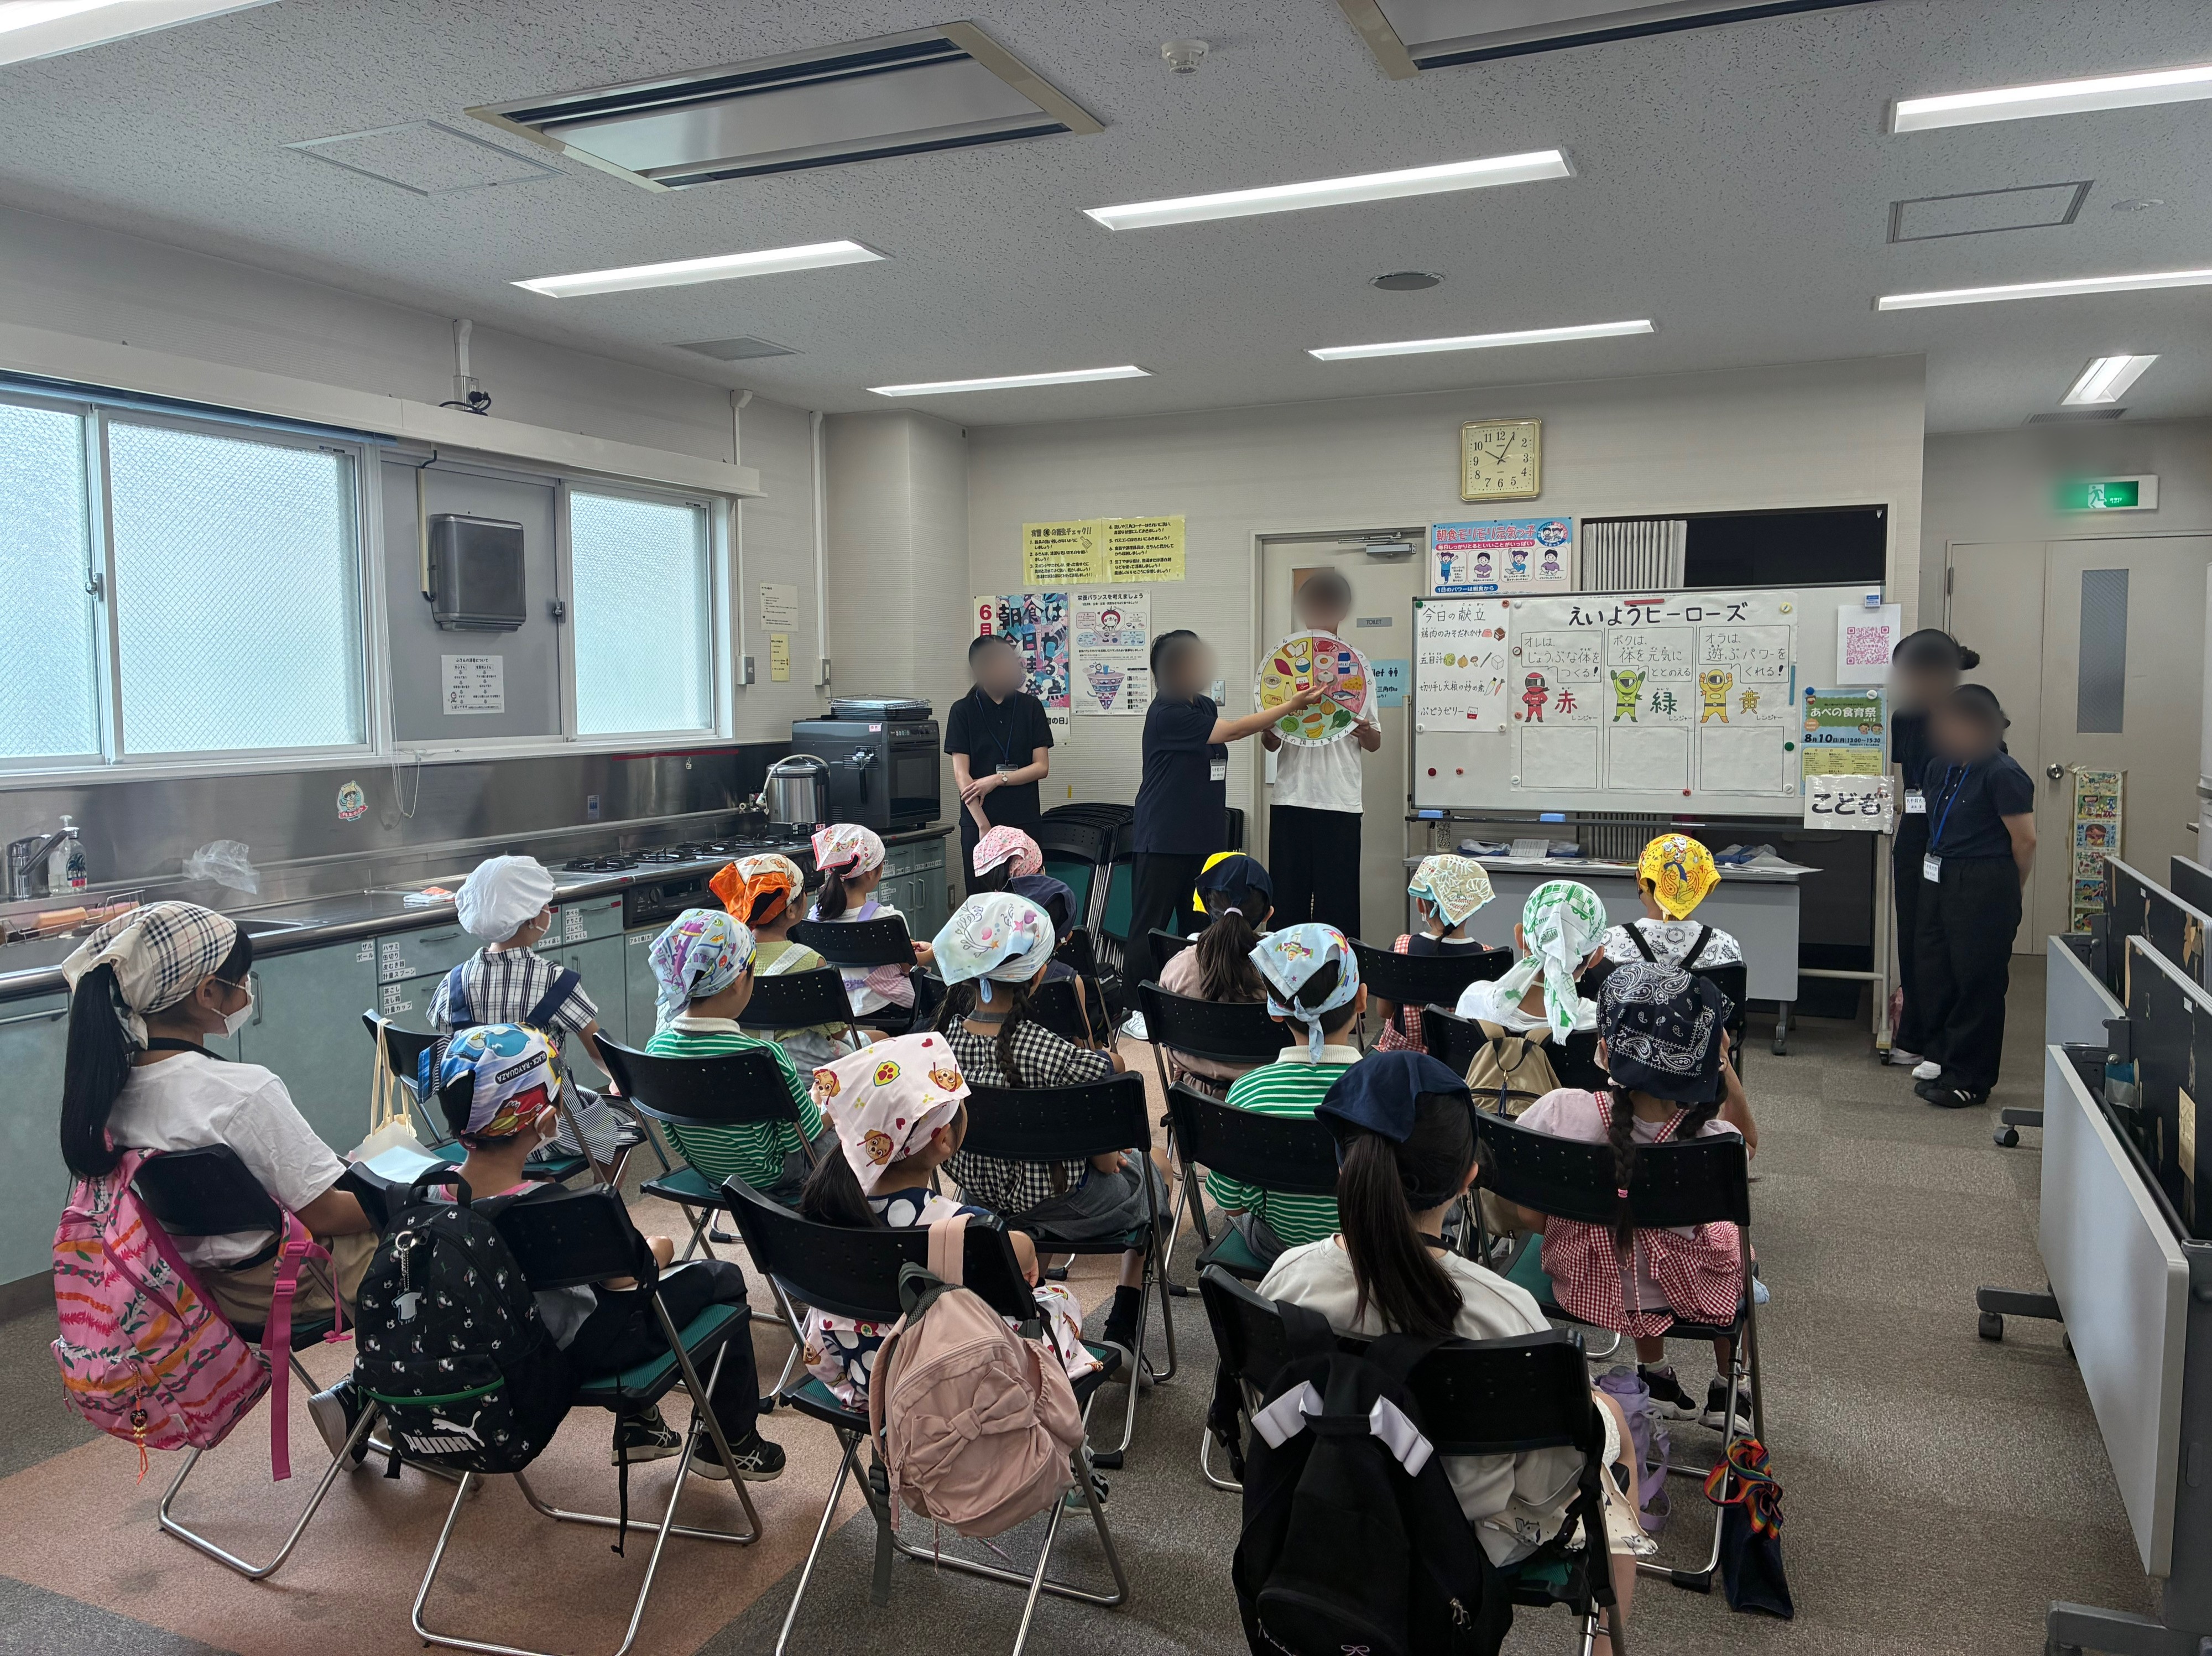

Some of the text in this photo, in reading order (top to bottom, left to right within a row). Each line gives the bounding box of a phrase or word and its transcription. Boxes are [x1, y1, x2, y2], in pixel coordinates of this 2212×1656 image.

[1484, 433, 1492, 442] 11
[1496, 431, 1505, 441] 12
[1474, 441, 1483, 451] 10
[1521, 438, 1527, 447] 2
[1473, 456, 1479, 466] 9
[1523, 453, 1528, 462] 3
[1475, 470, 1480, 480] 8
[1521, 467, 1527, 476] 4
[1485, 478, 1491, 487] 7
[1498, 478, 1503, 487] 6
[1511, 476, 1516, 486] 5
[1436, 524, 1536, 541] 朝食モリモリ元気っ子
[1438, 541, 1532, 550] 毎日しっかりとるといいことがいっぱい
[1077, 593, 1144, 601] 栄養バランスを考えましょう
[1423, 607, 1486, 623] 今日の献立
[1568, 602, 1748, 626] えいようヒーローズ
[1528, 650, 1599, 664] じょうぶな体を
[1619, 648, 1682, 663] 体を元気に
[1706, 648, 1786, 662] 遊ぶパワーを
[1372, 668, 1385, 678] let
[1652, 668, 1691, 676] ととのえる
[1554, 690, 1578, 714] 赤
[1650, 691, 1678, 715] 緑
[1739, 690, 1760, 714] 黄
[1811, 707, 1876, 718] あべの食育祭
[1812, 792, 1881, 815] こども
[383, 961, 404, 971] 皮むき器
[383, 969, 415, 980] 計量スプーン
[384, 996, 400, 1004] 流し箱
[385, 1003, 411, 1015] 計量カップ
[400, 1431, 477, 1454] PUMA
